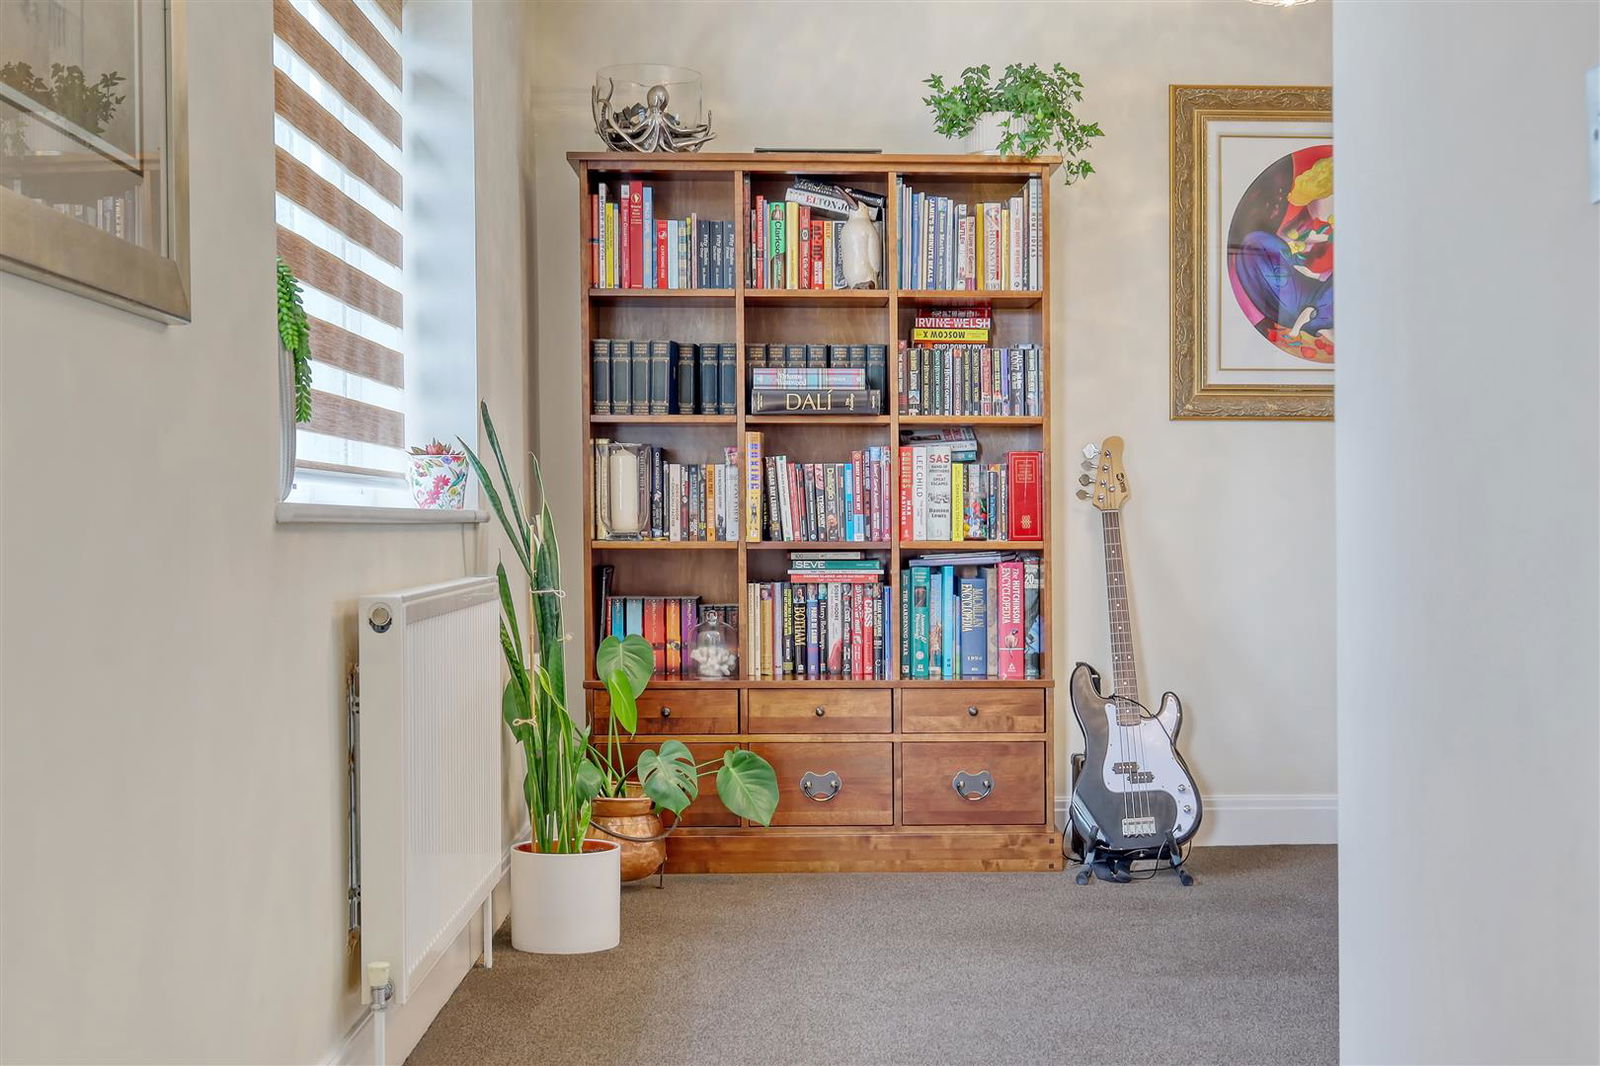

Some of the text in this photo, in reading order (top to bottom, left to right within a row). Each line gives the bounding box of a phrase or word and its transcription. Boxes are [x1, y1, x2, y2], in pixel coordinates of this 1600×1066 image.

[807, 195, 838, 208] ELTON
[928, 199, 936, 225] JAMIE'S
[774, 221, 782, 258] Clarkson
[939, 234, 947, 257] Martin
[928, 260, 936, 282] MEALS
[915, 318, 991, 328] IRVINE WELSH
[930, 331, 966, 339] MOSCOW
[787, 390, 831, 411] DALÍ
[750, 443, 760, 490] BOXING
[900, 452, 911, 489] SOLDIERS
[929, 455, 950, 463] SAS
[770, 497, 778, 521] LEONARD
[796, 561, 825, 569] SEVE
[855, 585, 862, 593] 30
[1002, 568, 1010, 624] ENCYCLOPEDIA
[1012, 580, 1020, 624] HUTCHINSON
[864, 599, 873, 628] CASS
[961, 583, 973, 633] ENCYCLOPEDIA
[973, 588, 984, 628] MACMILLAN
[794, 606, 806, 646] BOTHAM
[819, 621, 827, 650] Redknapp
